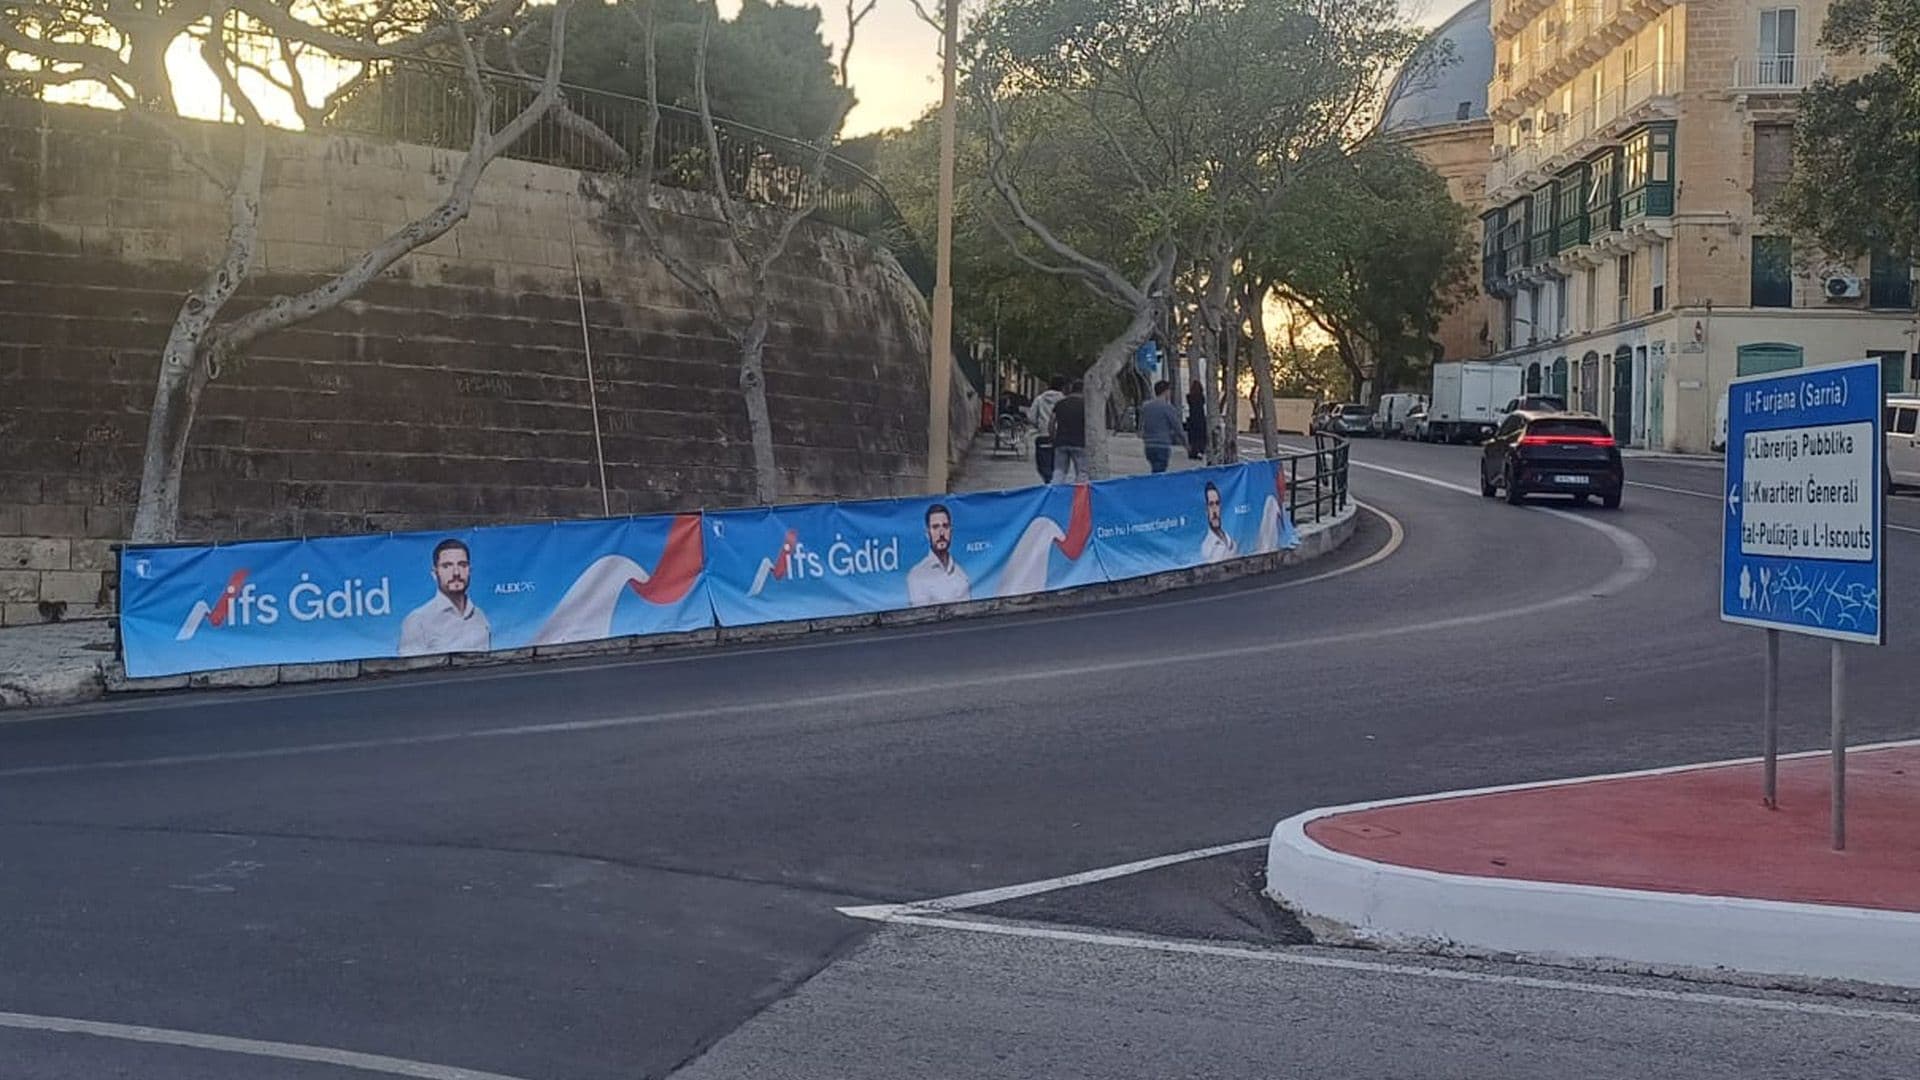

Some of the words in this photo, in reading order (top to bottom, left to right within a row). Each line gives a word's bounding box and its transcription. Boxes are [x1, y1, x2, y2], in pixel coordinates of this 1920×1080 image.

[1744, 387, 1796, 415] Il-Furjana
[1800, 376, 1848, 411] (Sarria)
[1802, 431, 1854, 456] Pubblika
[1743, 480, 1803, 503] Il-Kwartieri
[1807, 473, 1859, 503] Ġenerali
[1743, 522, 1798, 551] tal-Pulizija
[1802, 529, 1809, 546] u
[828, 533, 899, 576] Ġdid
[289, 573, 391, 621] Ġdid
